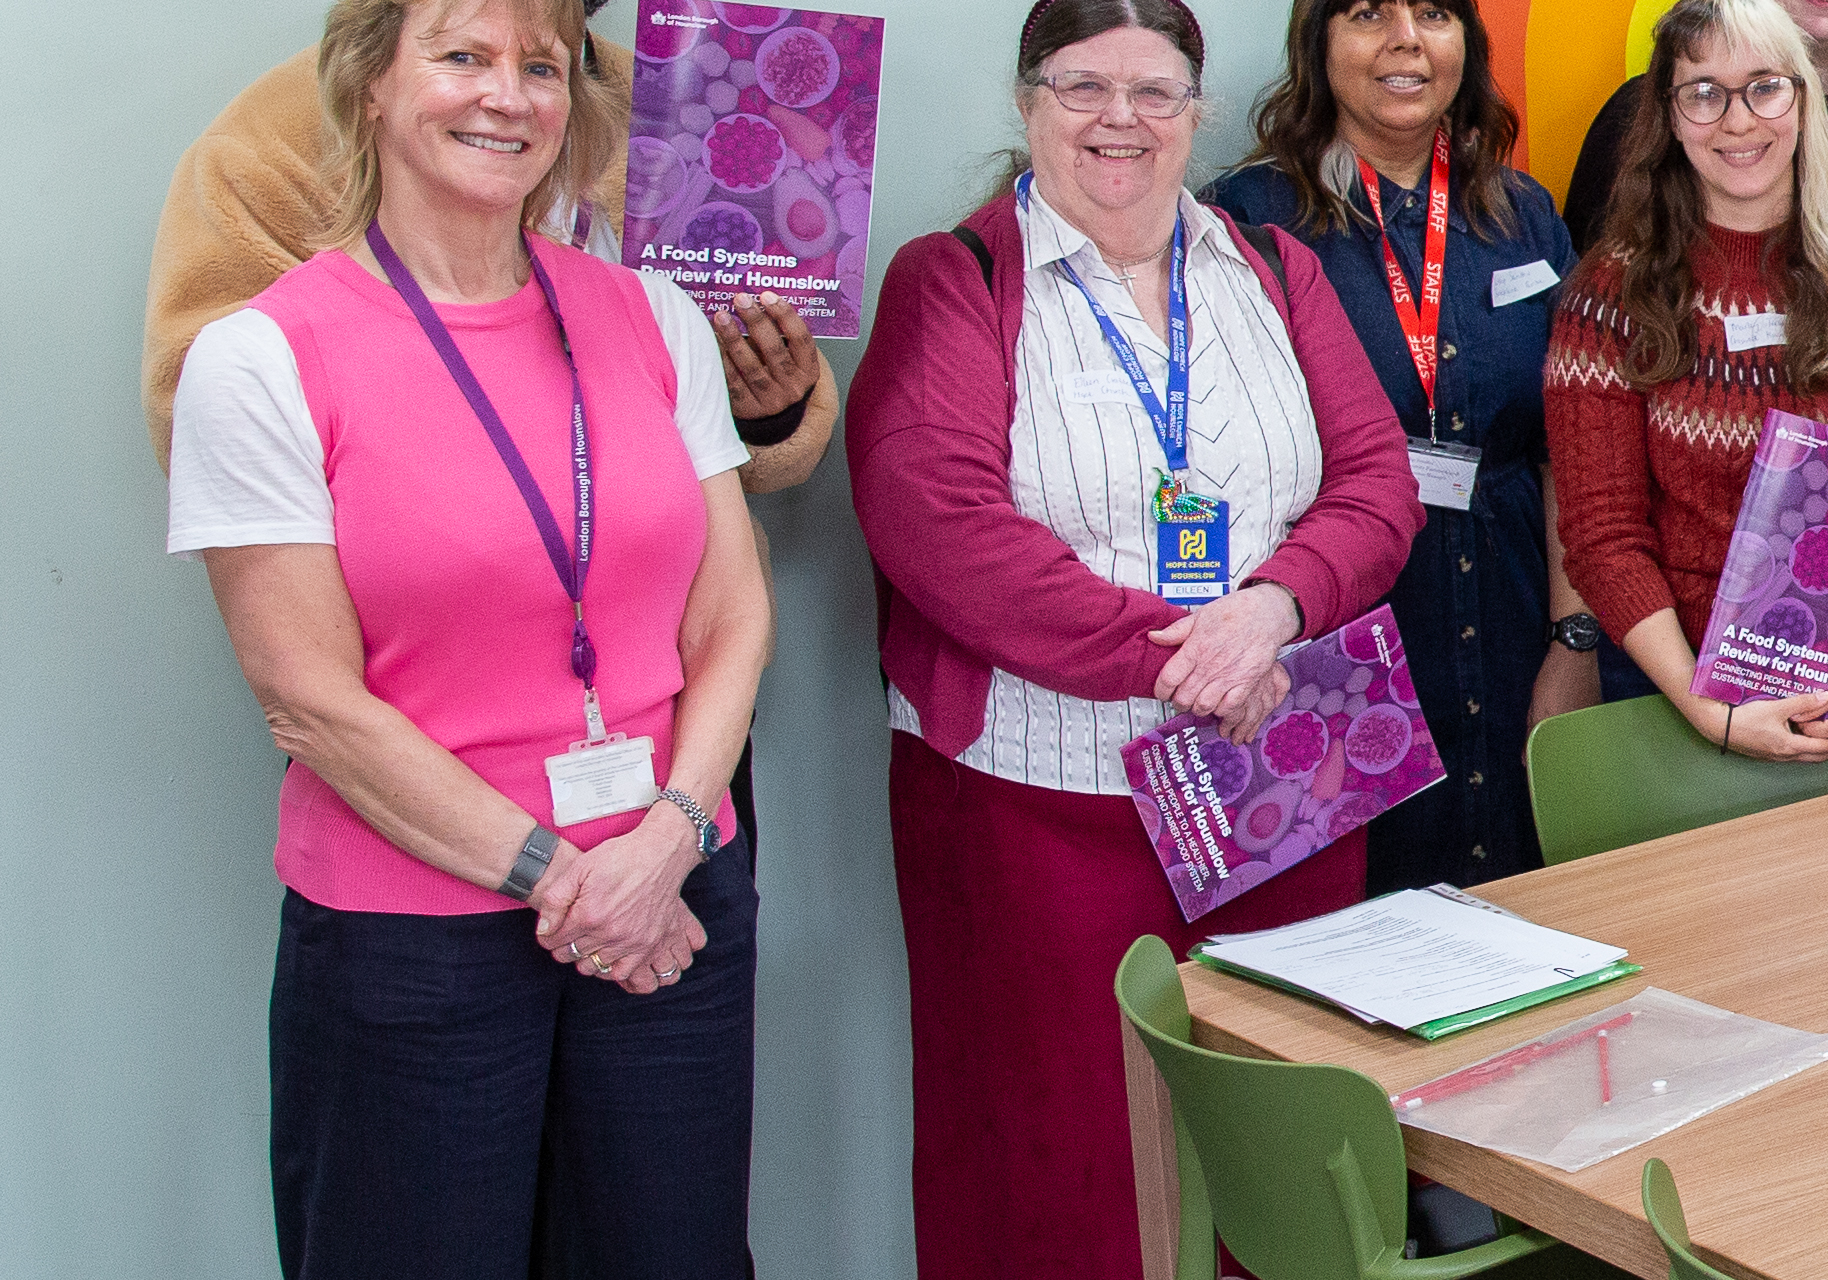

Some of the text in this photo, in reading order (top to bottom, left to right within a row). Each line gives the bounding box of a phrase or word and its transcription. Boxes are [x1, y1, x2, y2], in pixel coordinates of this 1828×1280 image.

[1432, 189, 1447, 233] STAFF
[641, 244, 798, 269] A Food Systems
[714, 270, 743, 286] for
[746, 271, 841, 292] Hounslow
[1387, 260, 1411, 304] STAFF
[1426, 261, 1442, 305] STAFF
[572, 403, 592, 562] London Borough of Hounslow
[1175, 585, 1209, 595] EILEEN
[1718, 641, 1771, 667] Review
[1770, 656, 1794, 674] for
[1723, 623, 1736, 639] A
[1738, 627, 1776, 650] Food
[1713, 660, 1812, 694] CONNECTING PEOPLE TO A
[1182, 725, 1233, 838] A Food Systems
[1141, 748, 1205, 894] SUSTAINABLE AND FAIRER FOOD SYSTEM
[1151, 743, 1211, 881] CONNECTING PEOPLE TO A HEALTHIER,
[1164, 733, 1230, 880] Review for Hounslow
